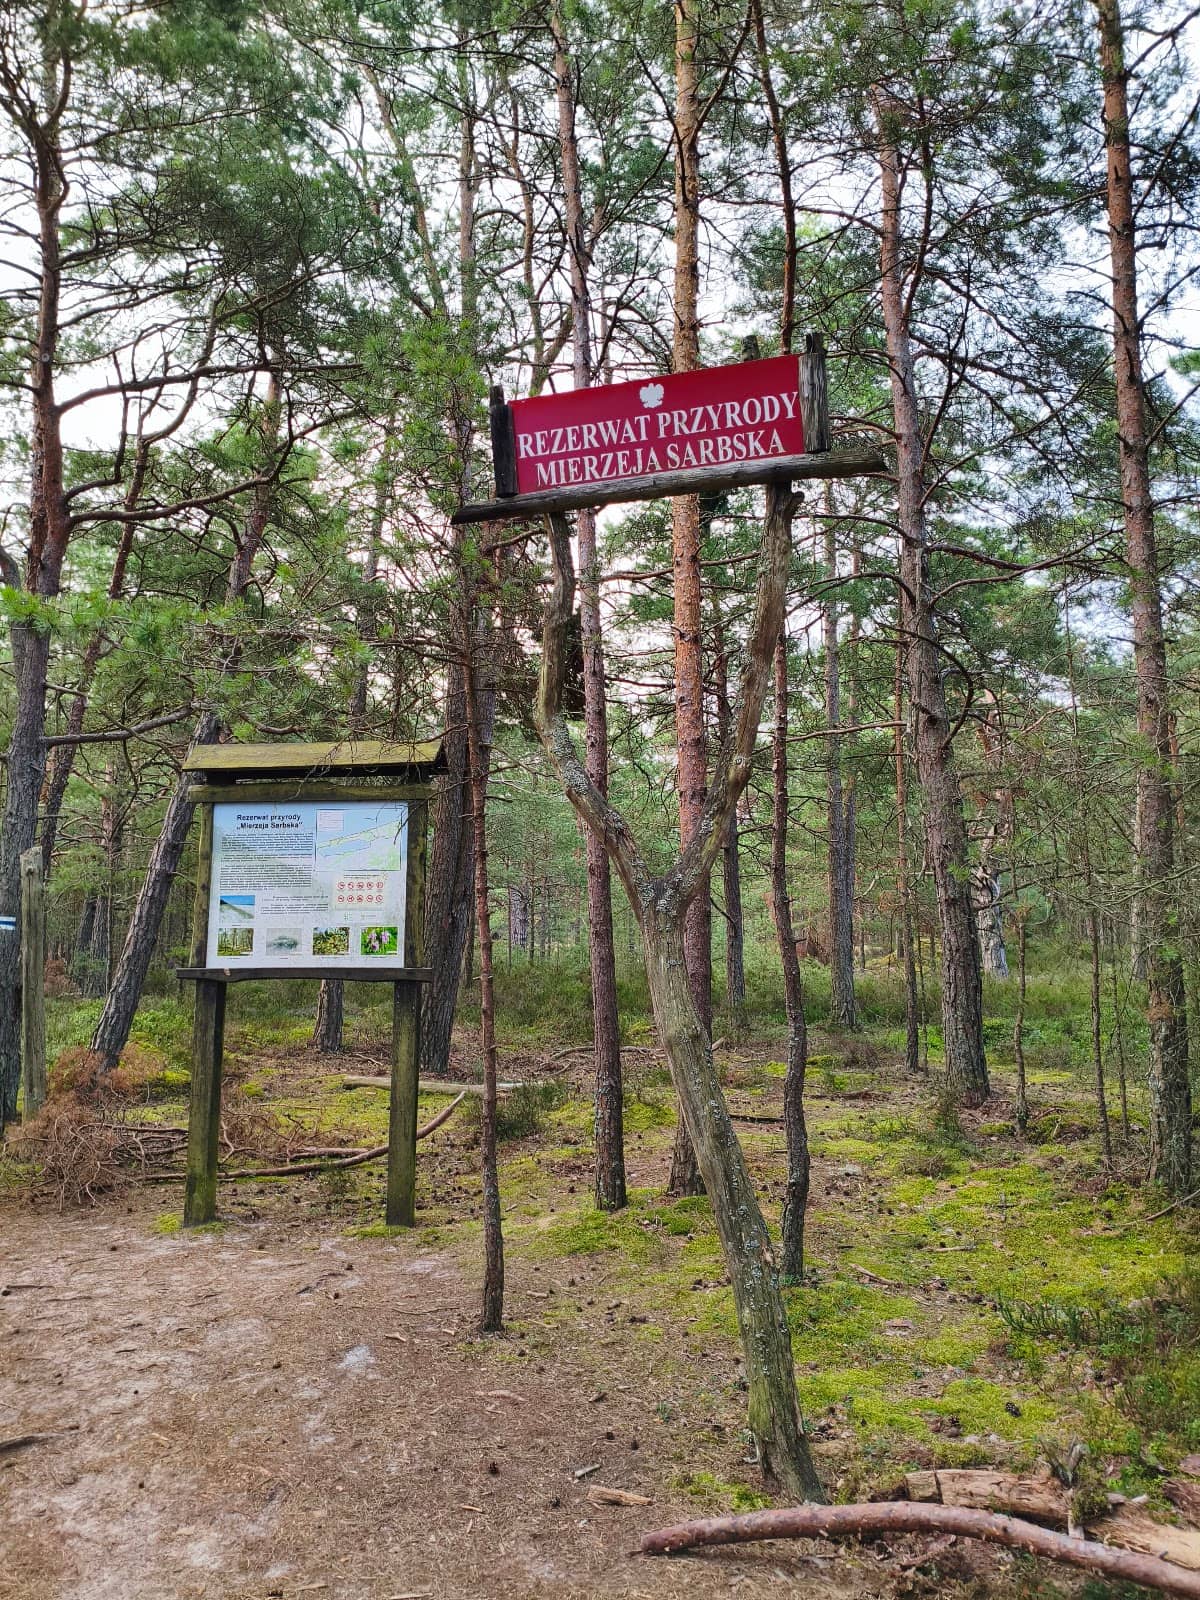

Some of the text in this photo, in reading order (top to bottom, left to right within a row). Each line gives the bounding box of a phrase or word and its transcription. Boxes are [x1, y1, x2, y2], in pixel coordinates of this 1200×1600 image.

[518, 391, 799, 459] REZERWAT PRZYRODY
[536, 429, 786, 487] MIERZEJA SARBSKA
[270, 814, 301, 822] przyrody
